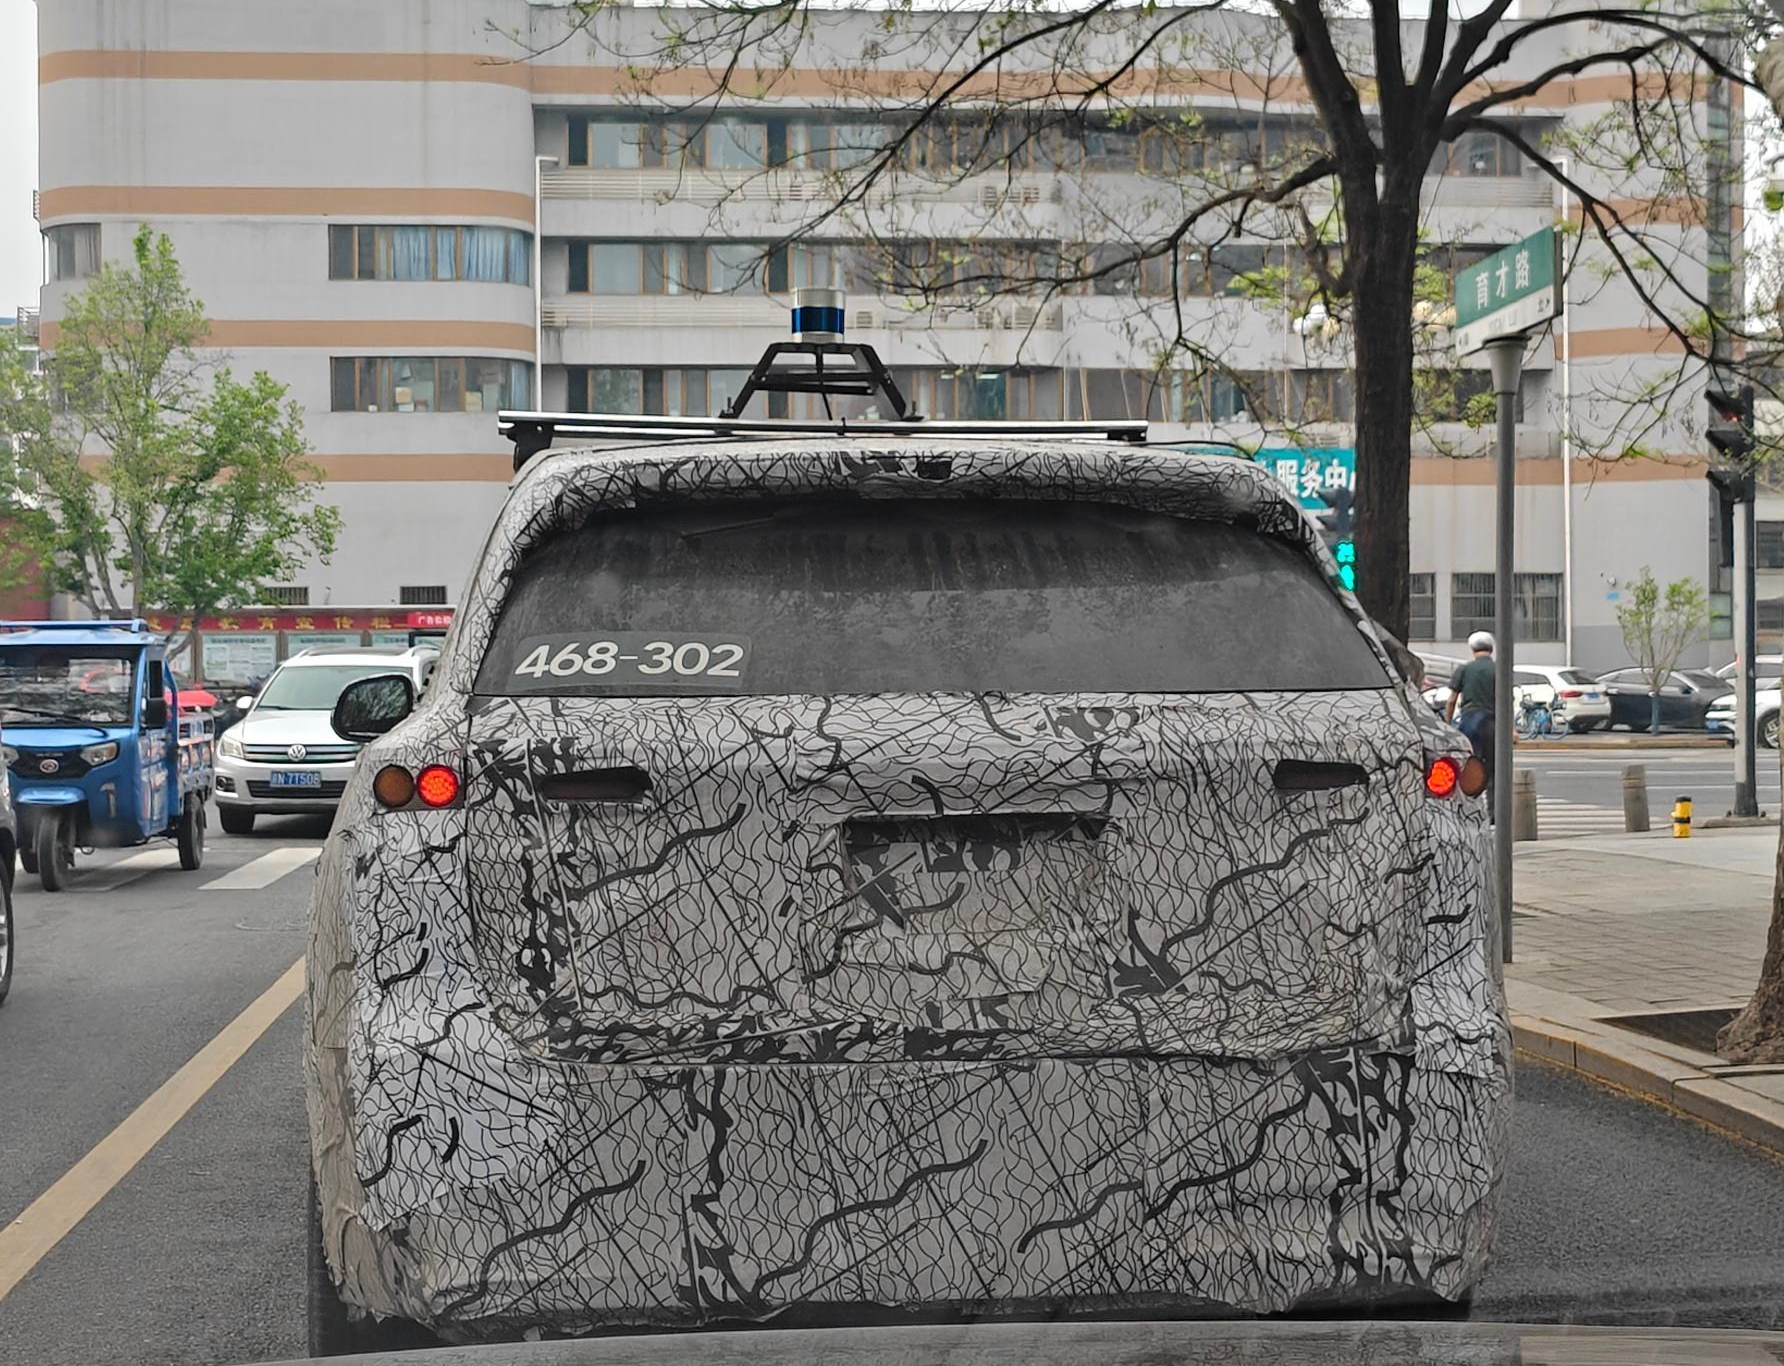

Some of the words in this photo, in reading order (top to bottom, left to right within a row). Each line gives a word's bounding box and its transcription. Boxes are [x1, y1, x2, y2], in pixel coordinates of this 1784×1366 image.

[1475, 248, 1530, 310] 育才路
[515, 641, 744, 678] 468-302
